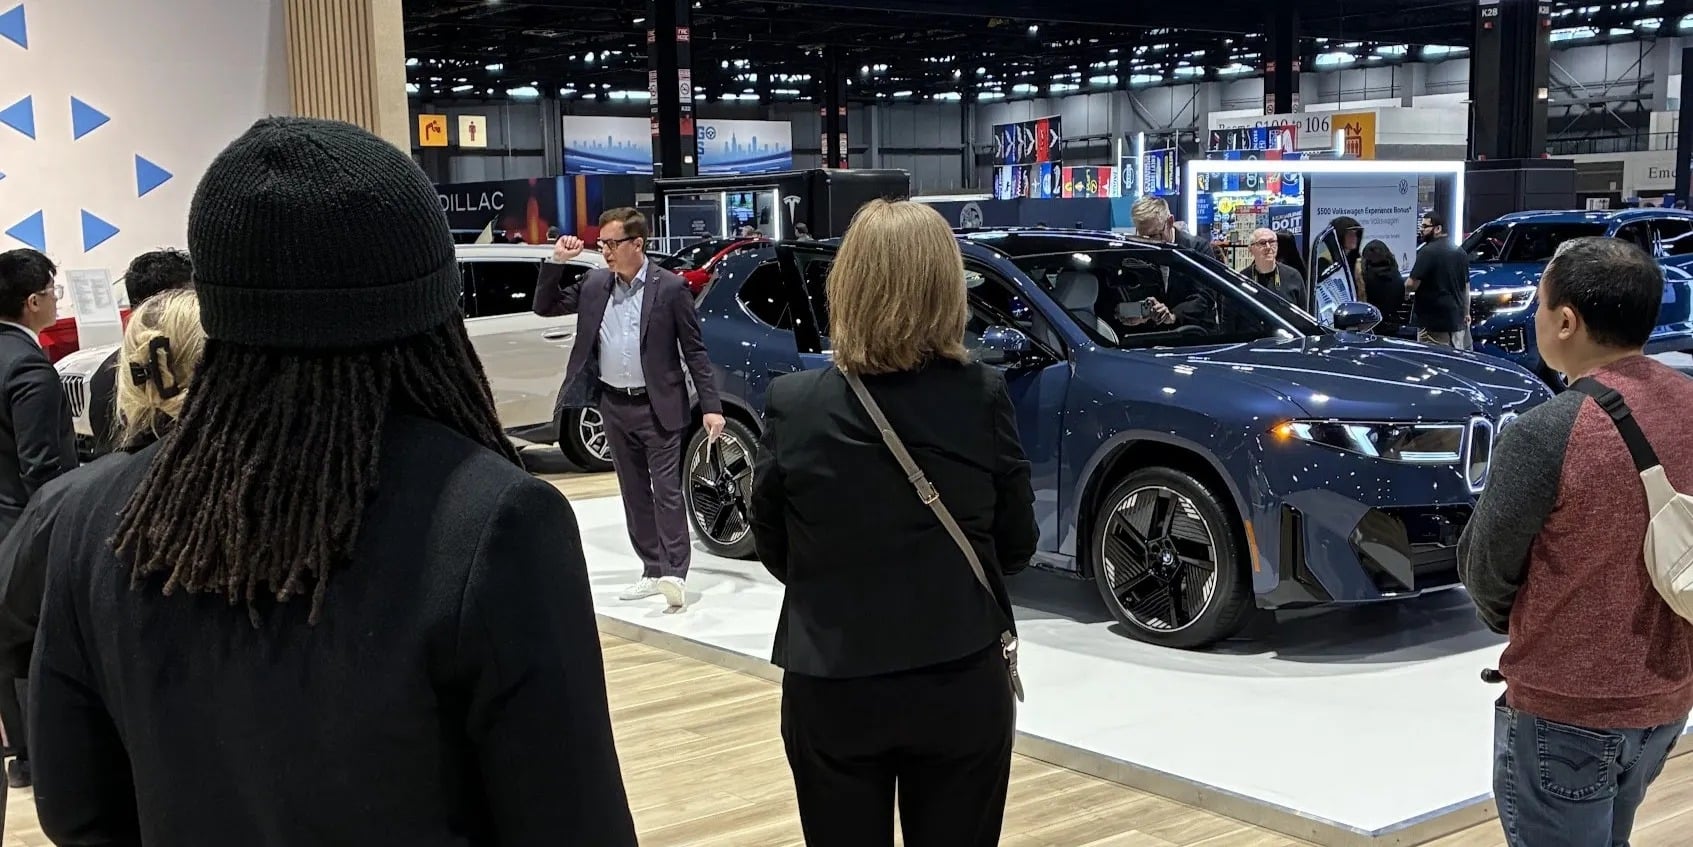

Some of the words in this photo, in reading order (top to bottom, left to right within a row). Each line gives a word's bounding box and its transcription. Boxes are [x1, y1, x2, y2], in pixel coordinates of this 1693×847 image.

[1481, 7, 1498, 17] K28
[1305, 116, 1329, 133] 106
[1317, 207, 1331, 216] $500
[1332, 207, 1364, 216] Volkswagen
[1365, 206, 1392, 216] Experience
[1272, 219, 1289, 231] DO
[1291, 216, 1302, 228] IT
